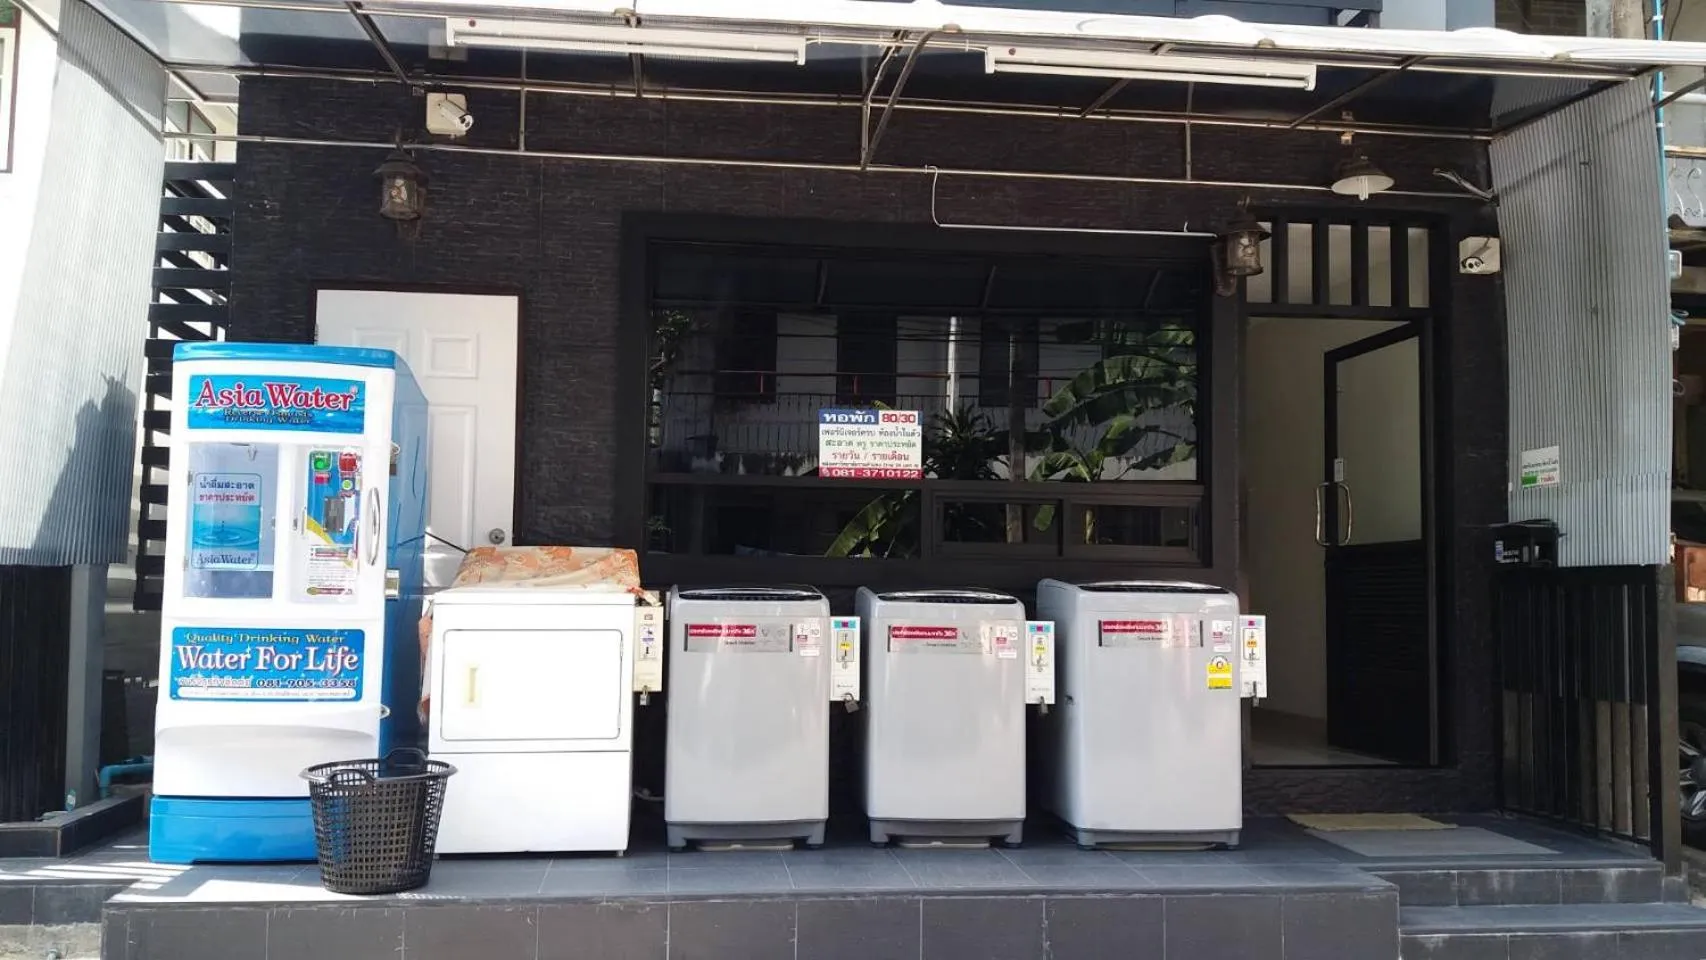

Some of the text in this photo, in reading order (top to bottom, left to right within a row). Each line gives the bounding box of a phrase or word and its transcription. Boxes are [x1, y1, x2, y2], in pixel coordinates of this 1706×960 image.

[195, 378, 353, 410] Asia Water
[882, 413, 916, 423] 80/30
[832, 469, 919, 478] 081-3710122
[186, 633, 345, 644] Quality Drinking Water
[175, 645, 358, 675] Water For Life
